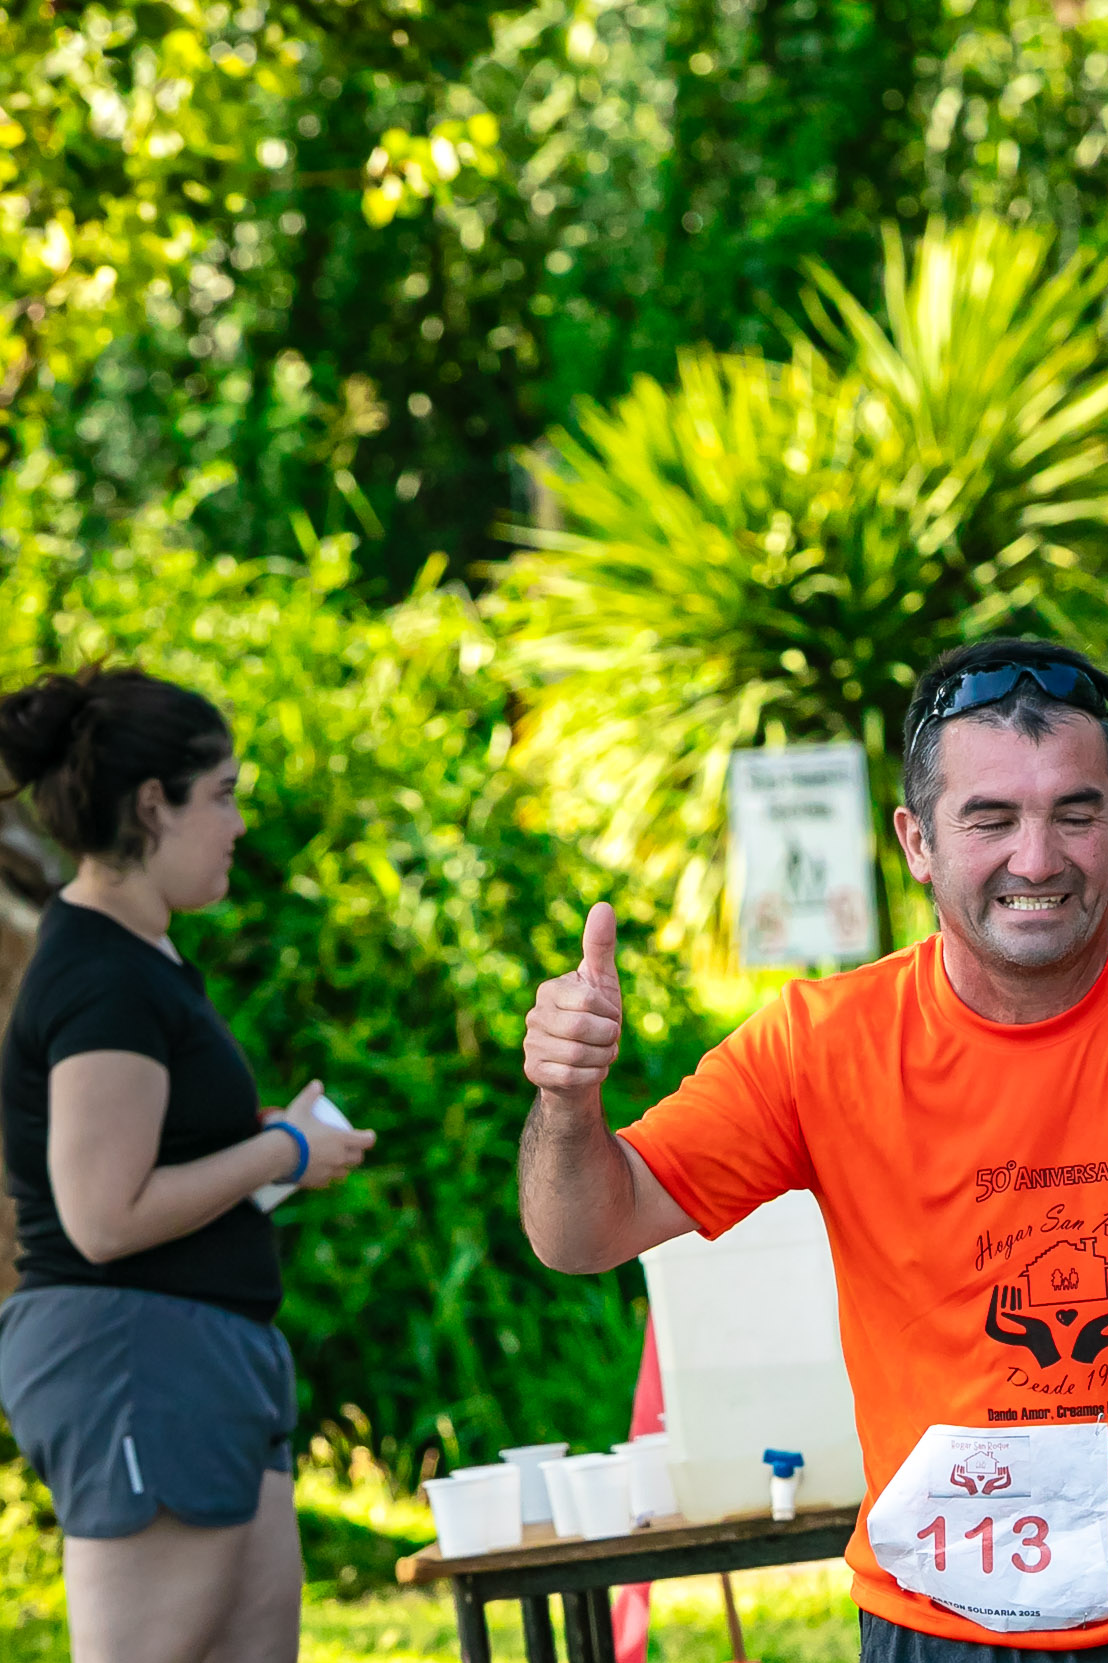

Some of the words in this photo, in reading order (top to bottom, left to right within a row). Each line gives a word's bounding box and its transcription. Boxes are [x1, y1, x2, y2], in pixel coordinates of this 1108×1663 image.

[975, 1225, 1033, 1271] Hogar
[1040, 1203, 1085, 1233] San
[1007, 1366, 1075, 1395] Desde
[988, 1408, 1018, 1422] Dando
[1057, 1404, 1105, 1419] Creamos
[916, 1515, 1052, 1574] 113
[967, 1606, 1017, 1617] SOLIDARIA
